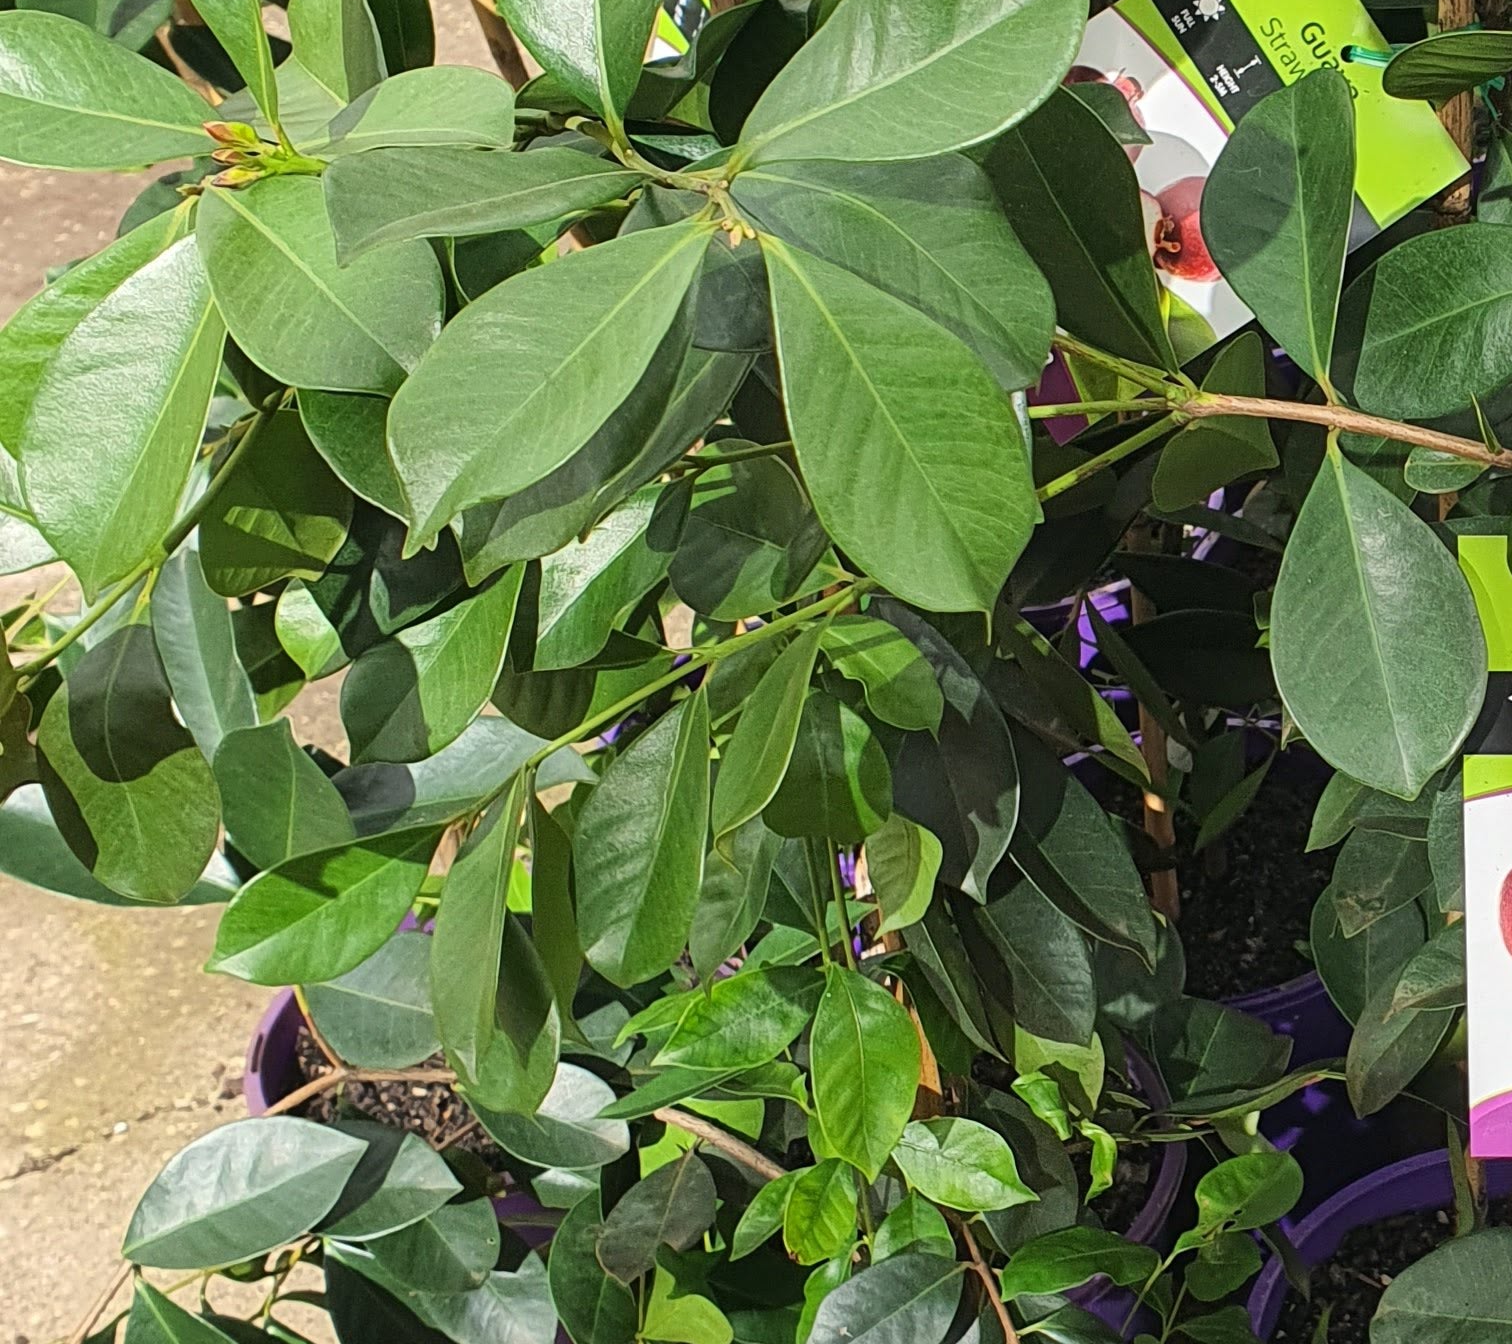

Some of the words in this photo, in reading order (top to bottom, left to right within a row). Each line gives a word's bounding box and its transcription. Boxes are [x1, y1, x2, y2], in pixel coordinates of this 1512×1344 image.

[1171, 15, 1187, 34] SUN
[1180, 8, 1196, 28] FULL
[1260, 18, 1306, 80] Straw
[1301, 22, 1358, 99] Gua
[1216, 64, 1240, 94] HEIGHT
